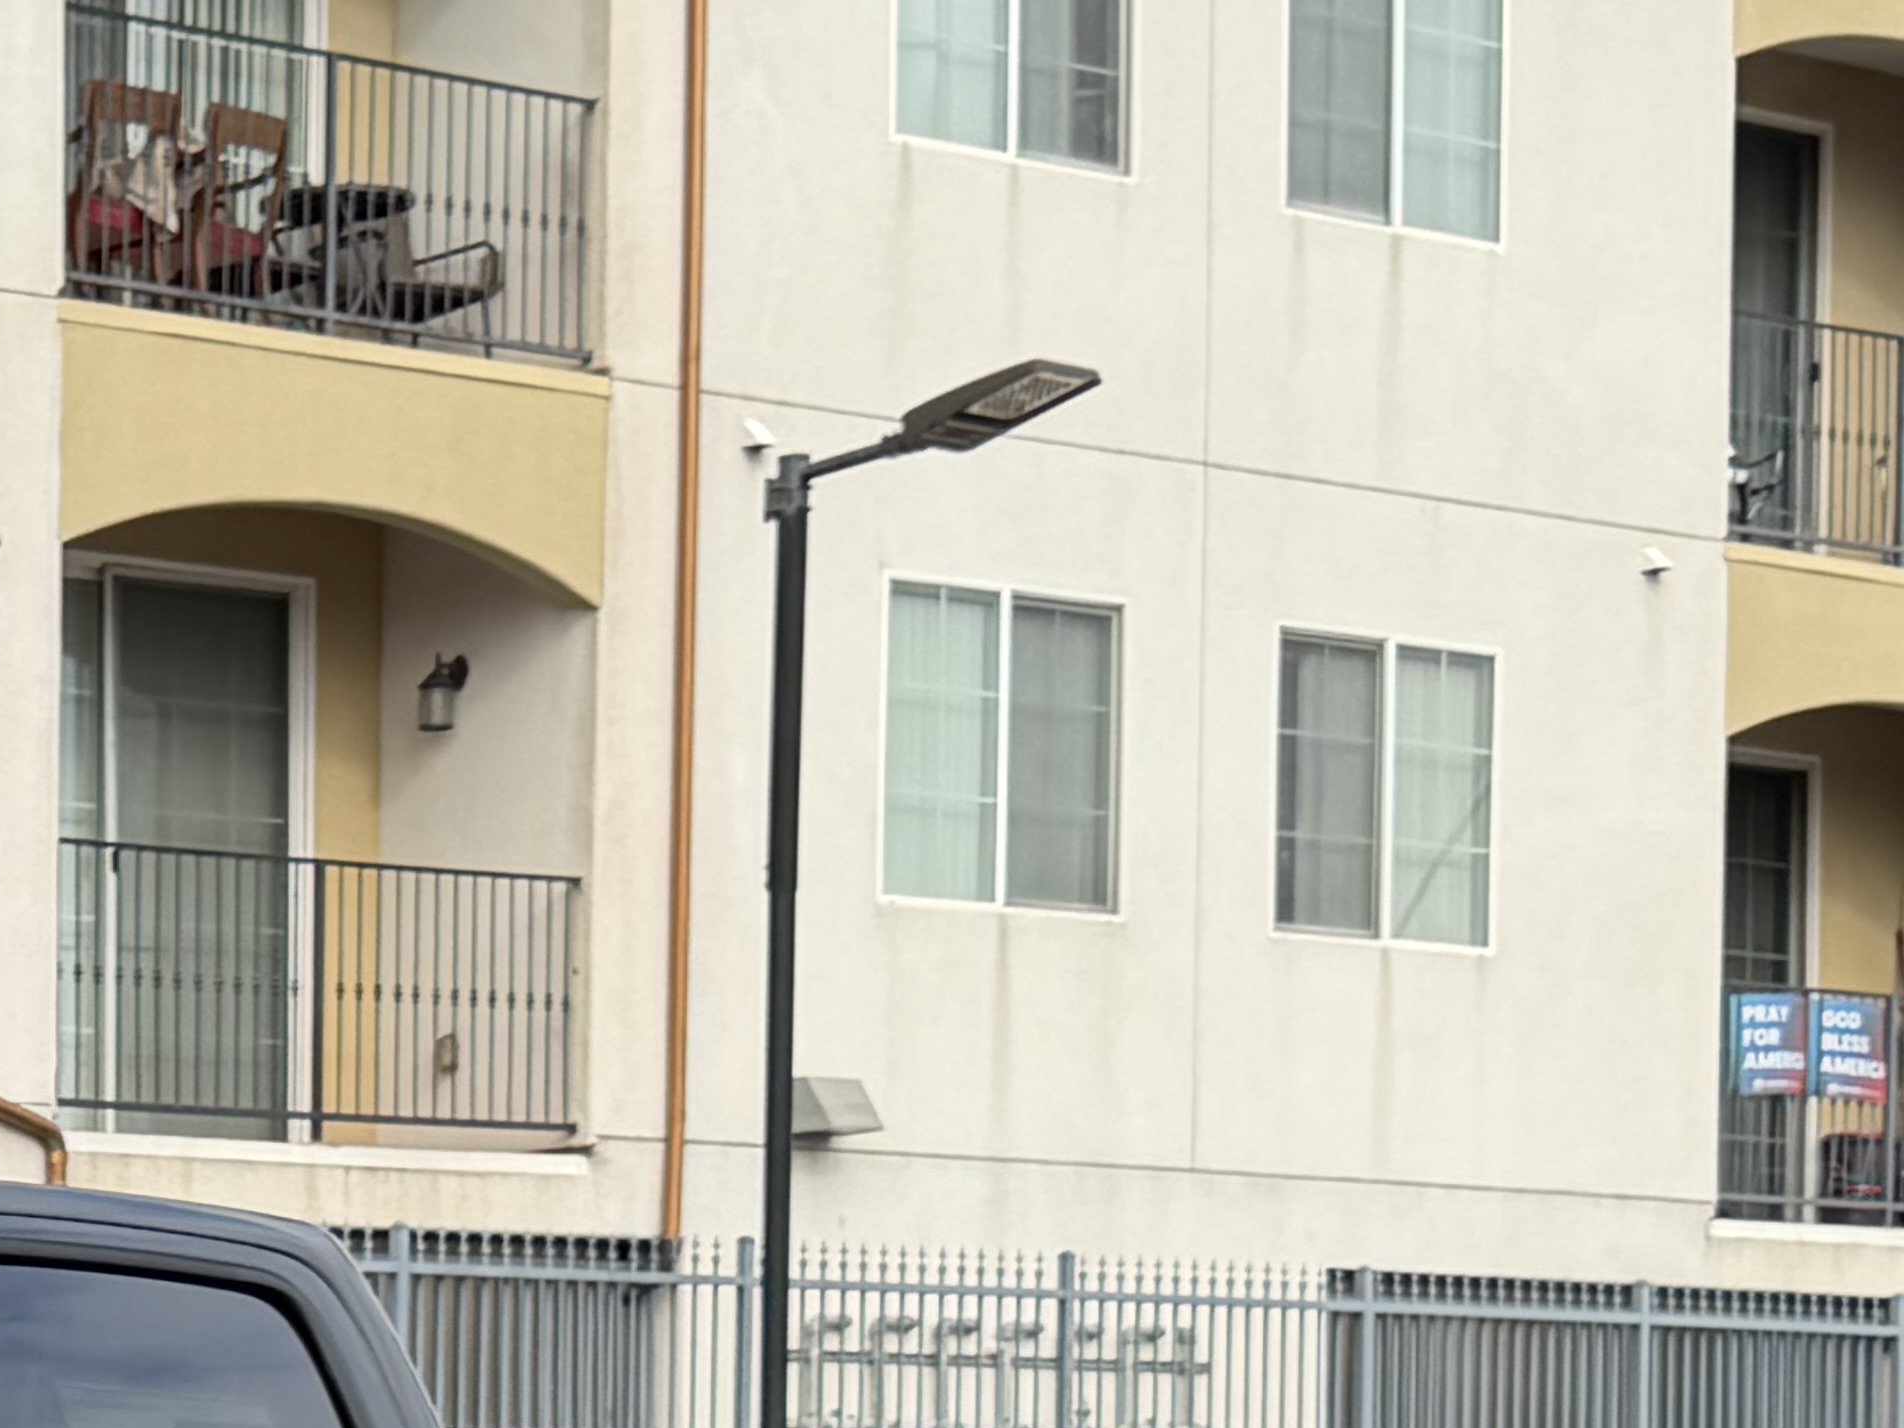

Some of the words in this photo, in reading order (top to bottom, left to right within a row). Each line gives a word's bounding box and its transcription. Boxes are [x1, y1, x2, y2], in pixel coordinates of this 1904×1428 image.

[1741, 1004, 1790, 1024] PRAY
[1742, 1027, 1780, 1047] FOR
[1821, 1031, 1871, 1054] BLESS
